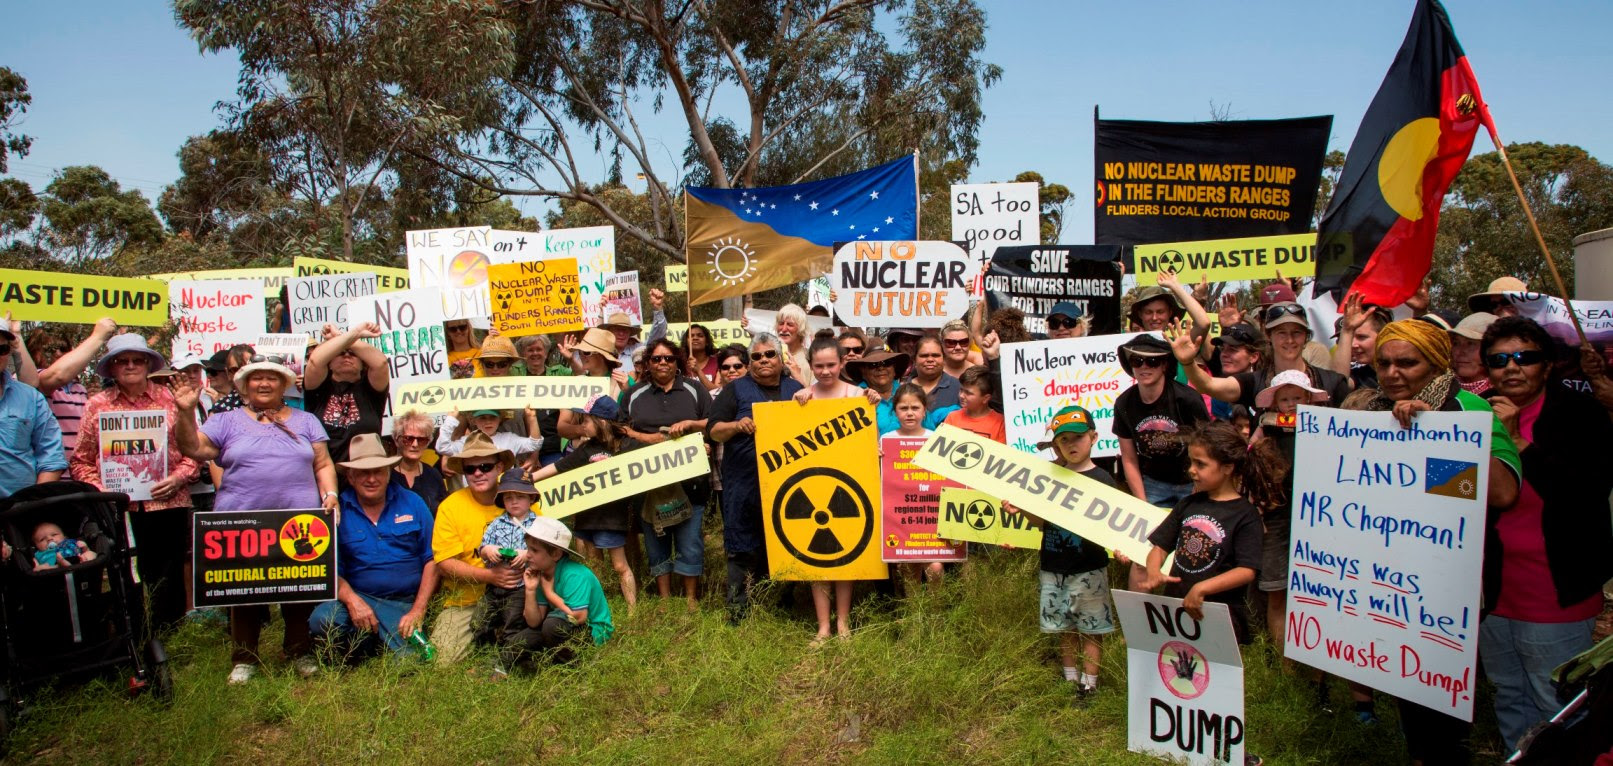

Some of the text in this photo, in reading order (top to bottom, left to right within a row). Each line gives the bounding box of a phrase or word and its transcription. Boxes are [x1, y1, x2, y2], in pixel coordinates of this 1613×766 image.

[1104, 162, 1297, 185] NO NUCLEAR WASTE DUMP
[957, 191, 1031, 216] SA too
[1108, 184, 1291, 207] IN THE FLINDERS RANGES
[1106, 204, 1290, 222] FLINDERS LOCAL ACTION GROUP
[412, 228, 491, 248] WE SAY
[493, 236, 528, 252] on't
[545, 234, 604, 255] Keep our
[964, 219, 1022, 250] good
[855, 241, 917, 261] NO
[1030, 249, 1070, 274] SAVE
[1187, 248, 1268, 270] WASTE
[520, 260, 546, 275] NO
[841, 260, 967, 289] NUCLEAR
[295, 279, 331, 301] OUR
[333, 277, 375, 299] GREAT
[491, 272, 579, 290] NUCLEAR WASTE
[514, 284, 553, 298] DUMP
[985, 274, 1010, 293] OUR
[1011, 276, 1065, 296] FLINDERS
[1066, 278, 1114, 297] RANGES
[82, 287, 162, 311] DUMP
[182, 288, 253, 310] Nuclear
[853, 291, 948, 317] FUTURE
[1011, 296, 1035, 314] FOR
[1509, 291, 1541, 304] NO
[293, 306, 332, 325] GREAT
[374, 299, 416, 331] NO
[492, 309, 541, 322] FLINDERS
[543, 305, 580, 317] RANGES
[1546, 304, 1558, 314] IN
[179, 316, 237, 335] Waste
[187, 339, 204, 356] is
[361, 325, 446, 356] CLEAR
[1014, 347, 1118, 375] Nuclear was
[449, 384, 527, 401] WASTE
[533, 384, 603, 399] DUMP
[1012, 377, 1119, 402] is dangerous
[101, 414, 165, 431] DON'T DUMP
[1296, 411, 1482, 449] It's Adnyamathanha
[113, 439, 155, 456] ON S.A.
[760, 406, 873, 474] DANGER
[543, 445, 699, 507] WASTE DUMP
[903, 472, 910, 481] &
[1336, 454, 1417, 488] LAND
[904, 493, 918, 503] $12
[918, 483, 930, 492] for
[894, 505, 926, 515] regional
[982, 453, 1084, 511] WASTE
[1083, 497, 1155, 547] DUM
[900, 517, 907, 525] &
[907, 516, 924, 525] 6-14
[1300, 490, 1465, 550] MR Chapman!
[204, 528, 277, 559] STOP
[1293, 539, 1360, 581] Always
[204, 564, 327, 583] CULTURAL GENOCIDE
[205, 589, 213, 597] of
[225, 587, 254, 596] WORLD'S
[254, 586, 277, 594] OLDEST
[277, 584, 298, 593] LIVING
[298, 583, 327, 592] CULTURE!
[1290, 570, 1469, 641] Always will be!
[1143, 601, 1201, 641] NO
[1287, 611, 1470, 708] NO waste Dump!
[1150, 697, 1244, 764] DUMP
